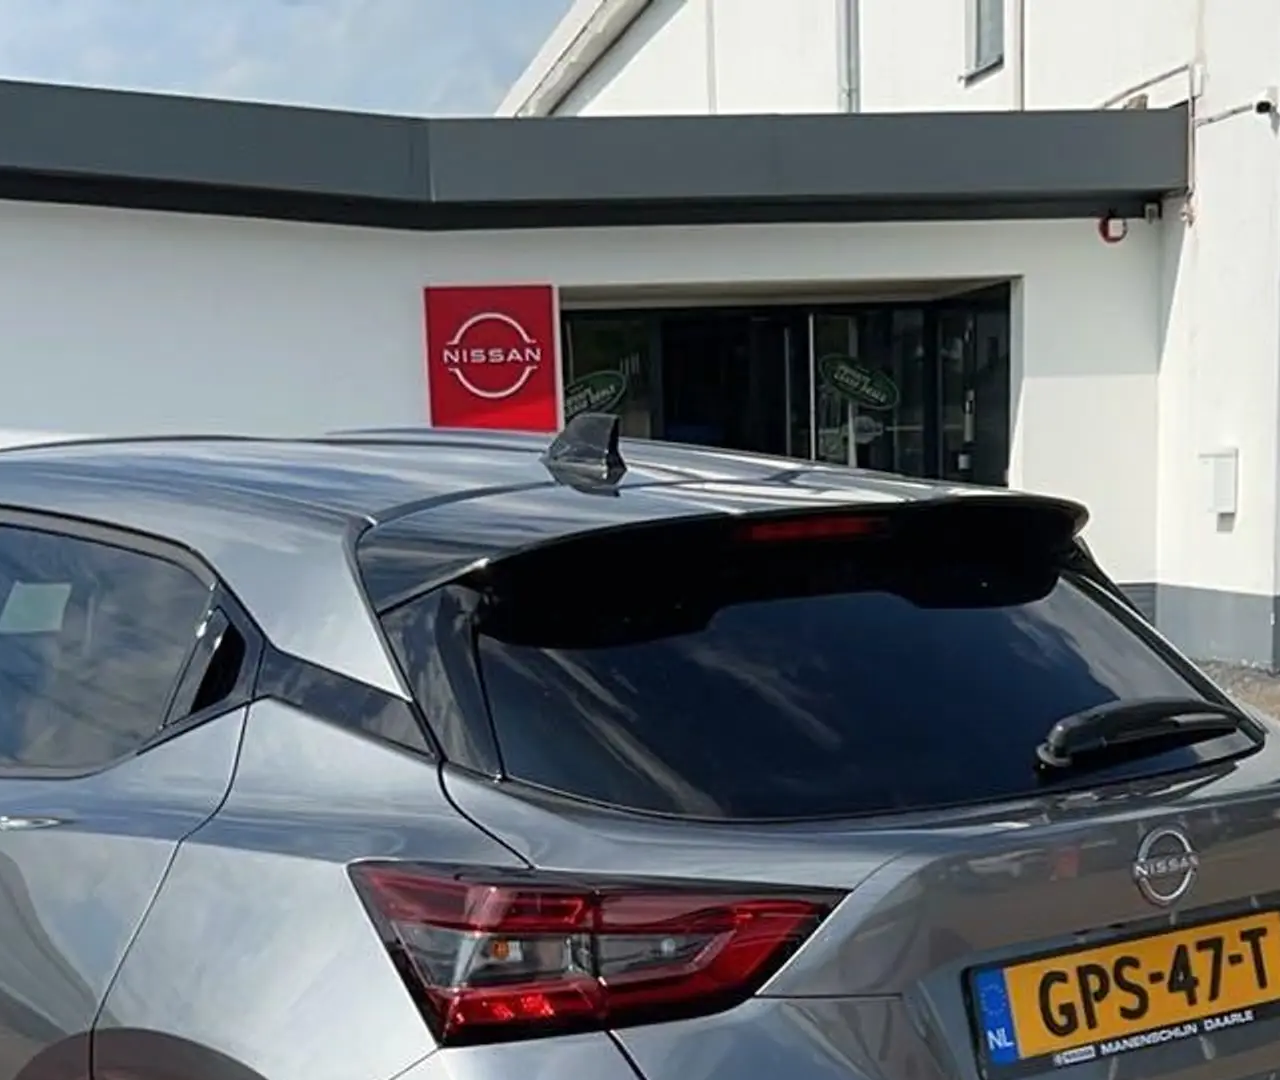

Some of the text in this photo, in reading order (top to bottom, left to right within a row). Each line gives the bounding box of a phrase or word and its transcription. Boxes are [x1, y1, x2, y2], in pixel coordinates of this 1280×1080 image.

[443, 347, 542, 364] NISSAN
[1134, 854, 1200, 877] NISSAN
[1038, 927, 1268, 1038] GPS-47-T
[1203, 1010, 1255, 1032] DAARLE
[986, 1027, 1015, 1051] NL
